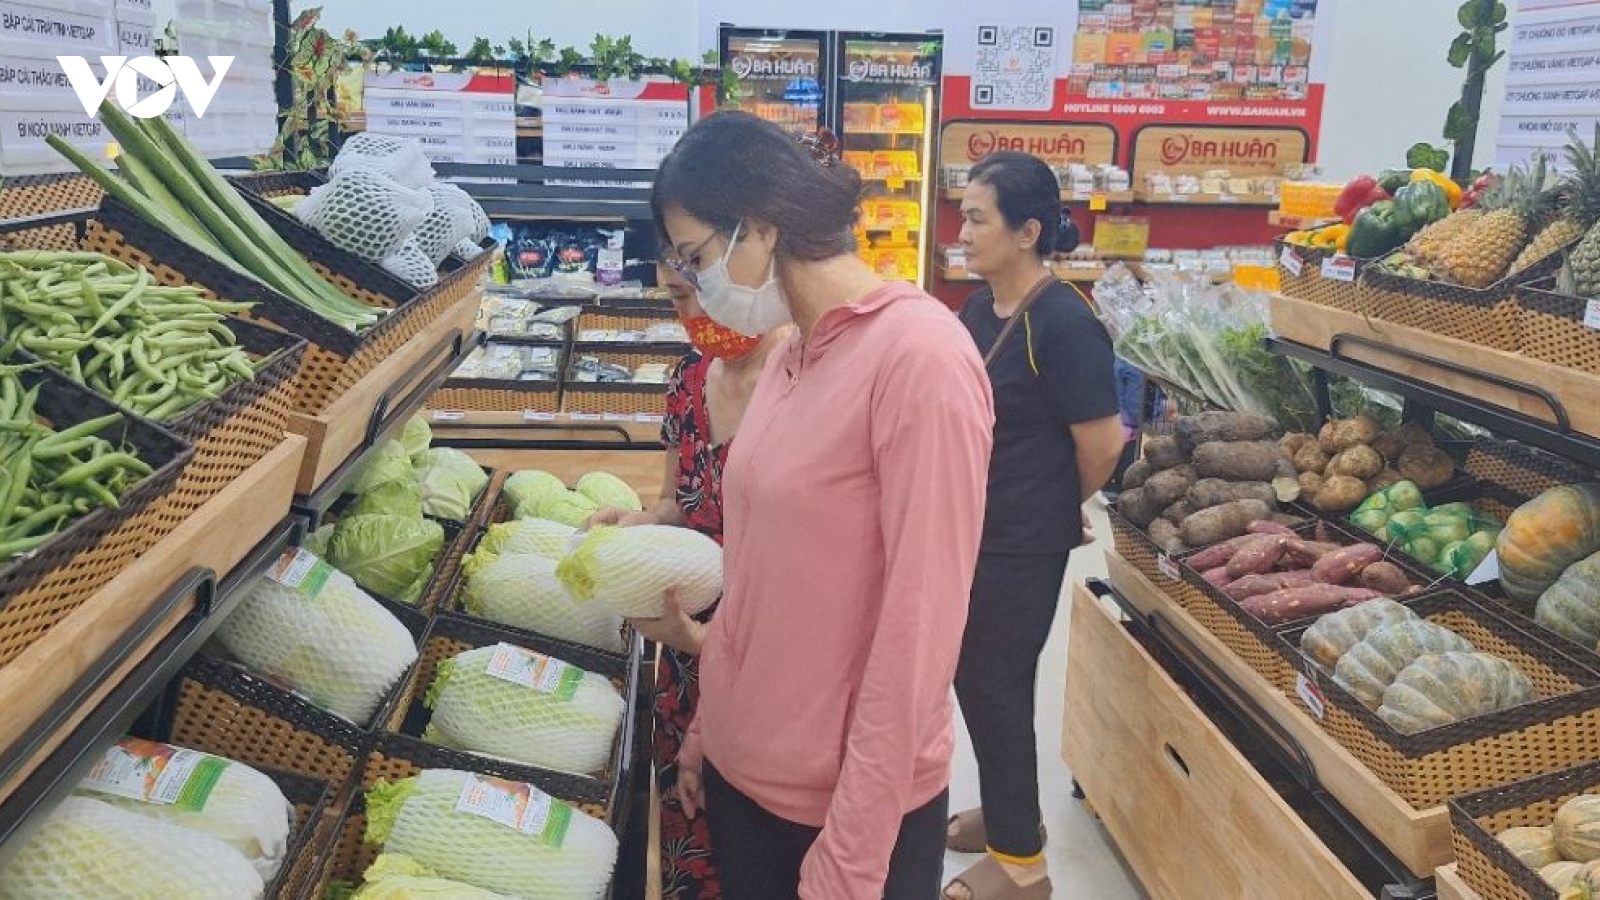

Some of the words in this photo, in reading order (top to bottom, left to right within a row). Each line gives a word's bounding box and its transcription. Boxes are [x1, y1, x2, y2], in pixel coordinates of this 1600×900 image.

[754, 60, 771, 74] BA
[869, 63, 888, 77] BA
[1064, 103, 1110, 113] HOTLINE
[998, 136, 1024, 152] BA
[1191, 140, 1217, 156] BA
[1220, 137, 1277, 158] HUÂN
